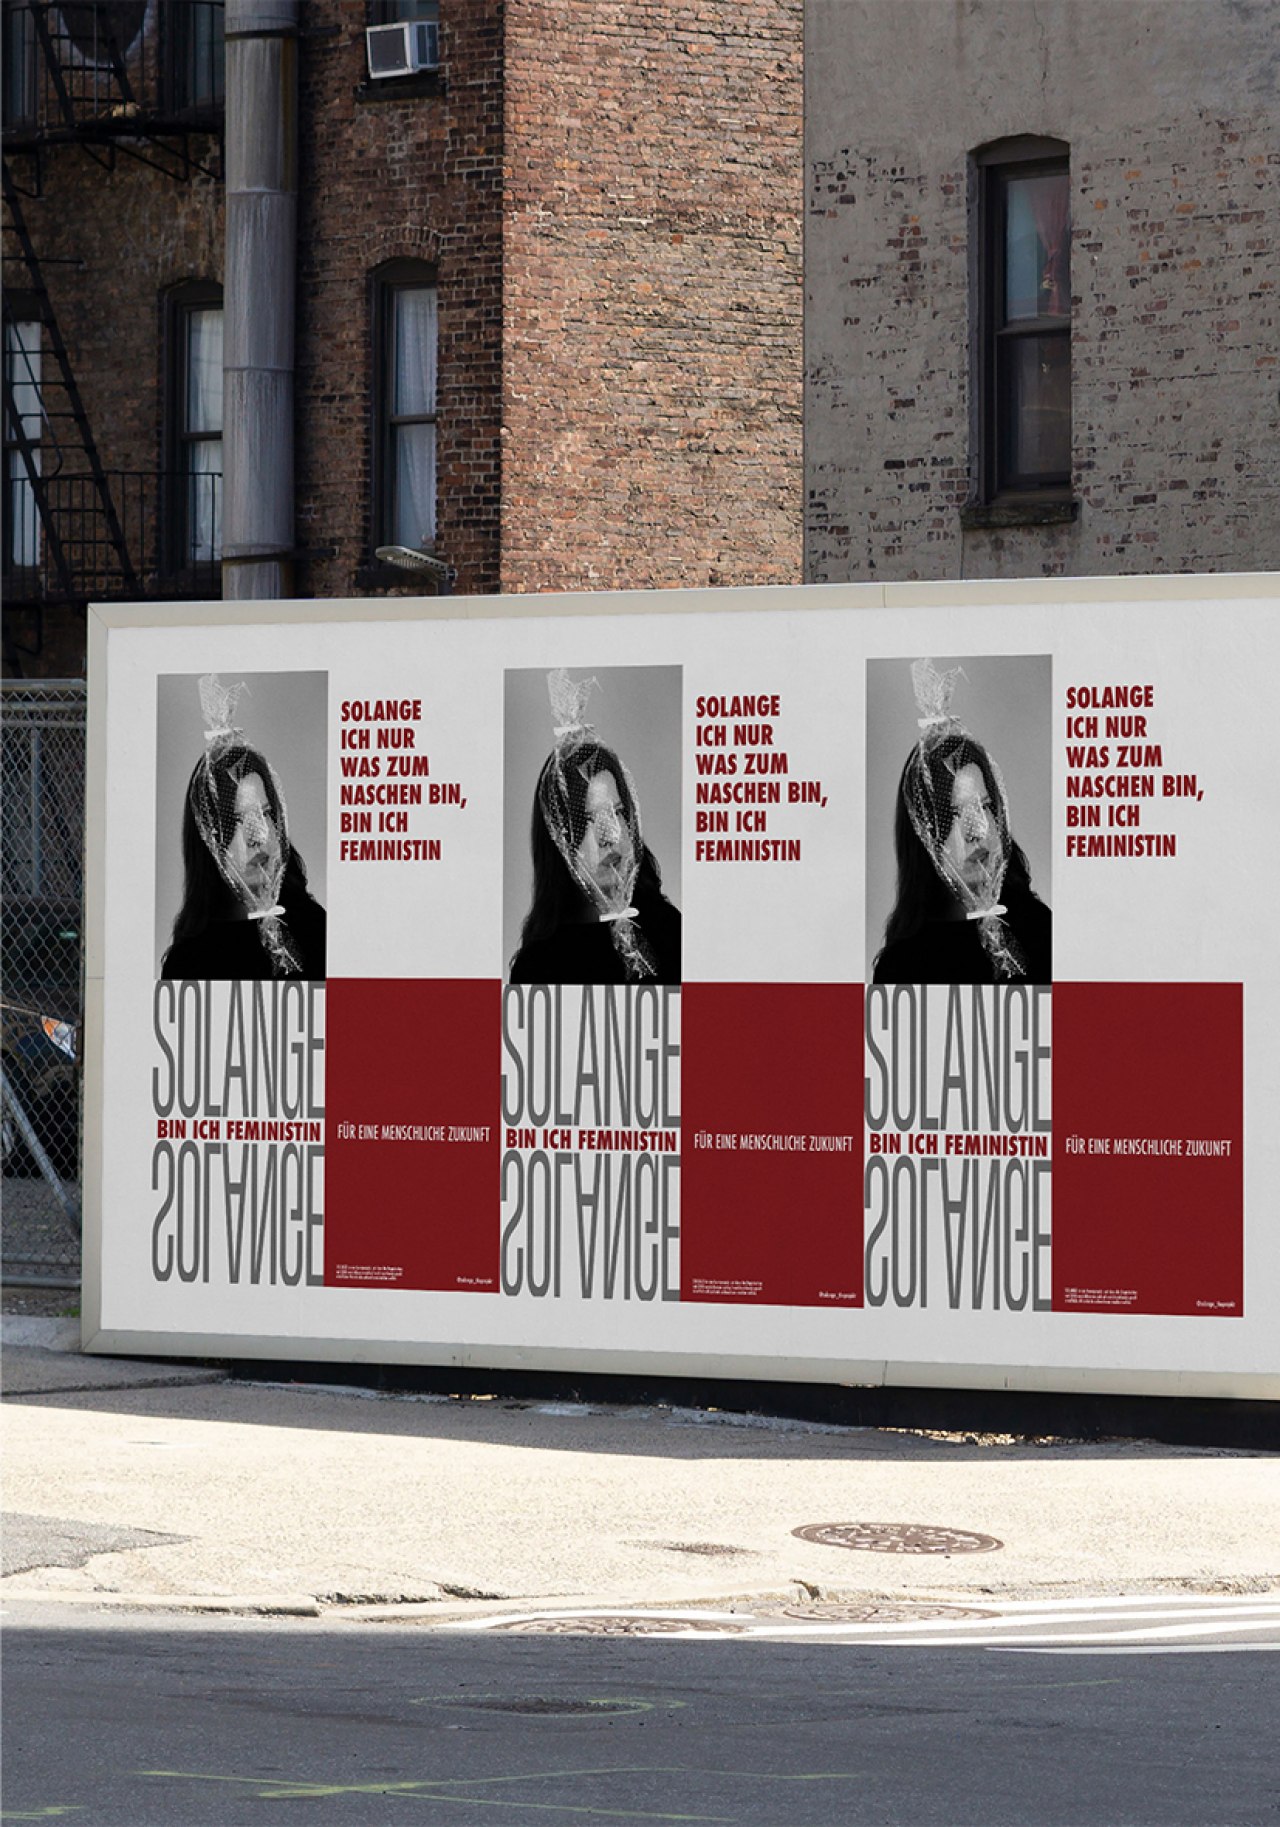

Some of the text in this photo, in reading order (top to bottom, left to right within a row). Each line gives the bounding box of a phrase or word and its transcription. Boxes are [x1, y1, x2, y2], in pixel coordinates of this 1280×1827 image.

[697, 696, 780, 718] SOLANGE
[1067, 686, 1153, 708] SOLANGE
[342, 700, 421, 721] SOLANGE
[697, 724, 773, 746] ICH NUR
[1067, 716, 1147, 738] ICH NUR
[342, 728, 415, 749] ICH NUR
[342, 756, 429, 777] WAS ZUM
[696, 753, 789, 775] WAS ZUM
[1066, 746, 1163, 768] WAS ZUM
[341, 784, 467, 808] NASCHEN BIN,
[697, 782, 827, 807] NASCHEN BIN,
[1067, 775, 1204, 800] NASCHEN BIN,
[341, 812, 408, 832] BIN ICH
[697, 811, 767, 832] BIN ICH
[1067, 805, 1140, 826] BIN ICH
[341, 840, 441, 861] FEMINISTIN
[696, 840, 801, 861] FEMINISTIN
[1067, 834, 1176, 856] FEMINISTIN
[153, 980, 325, 1120] SOLANGE
[501, 984, 681, 1129] SOLANGE
[864, 984, 1052, 1133] SOLANGE
[158, 1120, 321, 1142] BIN ICH FEMINISTIN
[338, 1121, 491, 1142] FÜR EINE MENSCHLICHE ZUKUNFT
[506, 1129, 677, 1151] BIN ICH FEMINISTIN
[694, 1130, 853, 1152] FÜR EINE MENSCHLICHE ZUKUNFT
[869, 1133, 1048, 1157] BIN ICH FEMINISTIN
[1065, 1134, 1232, 1157] FÜR EINE MENSCHLICHE ZUKUNFT
